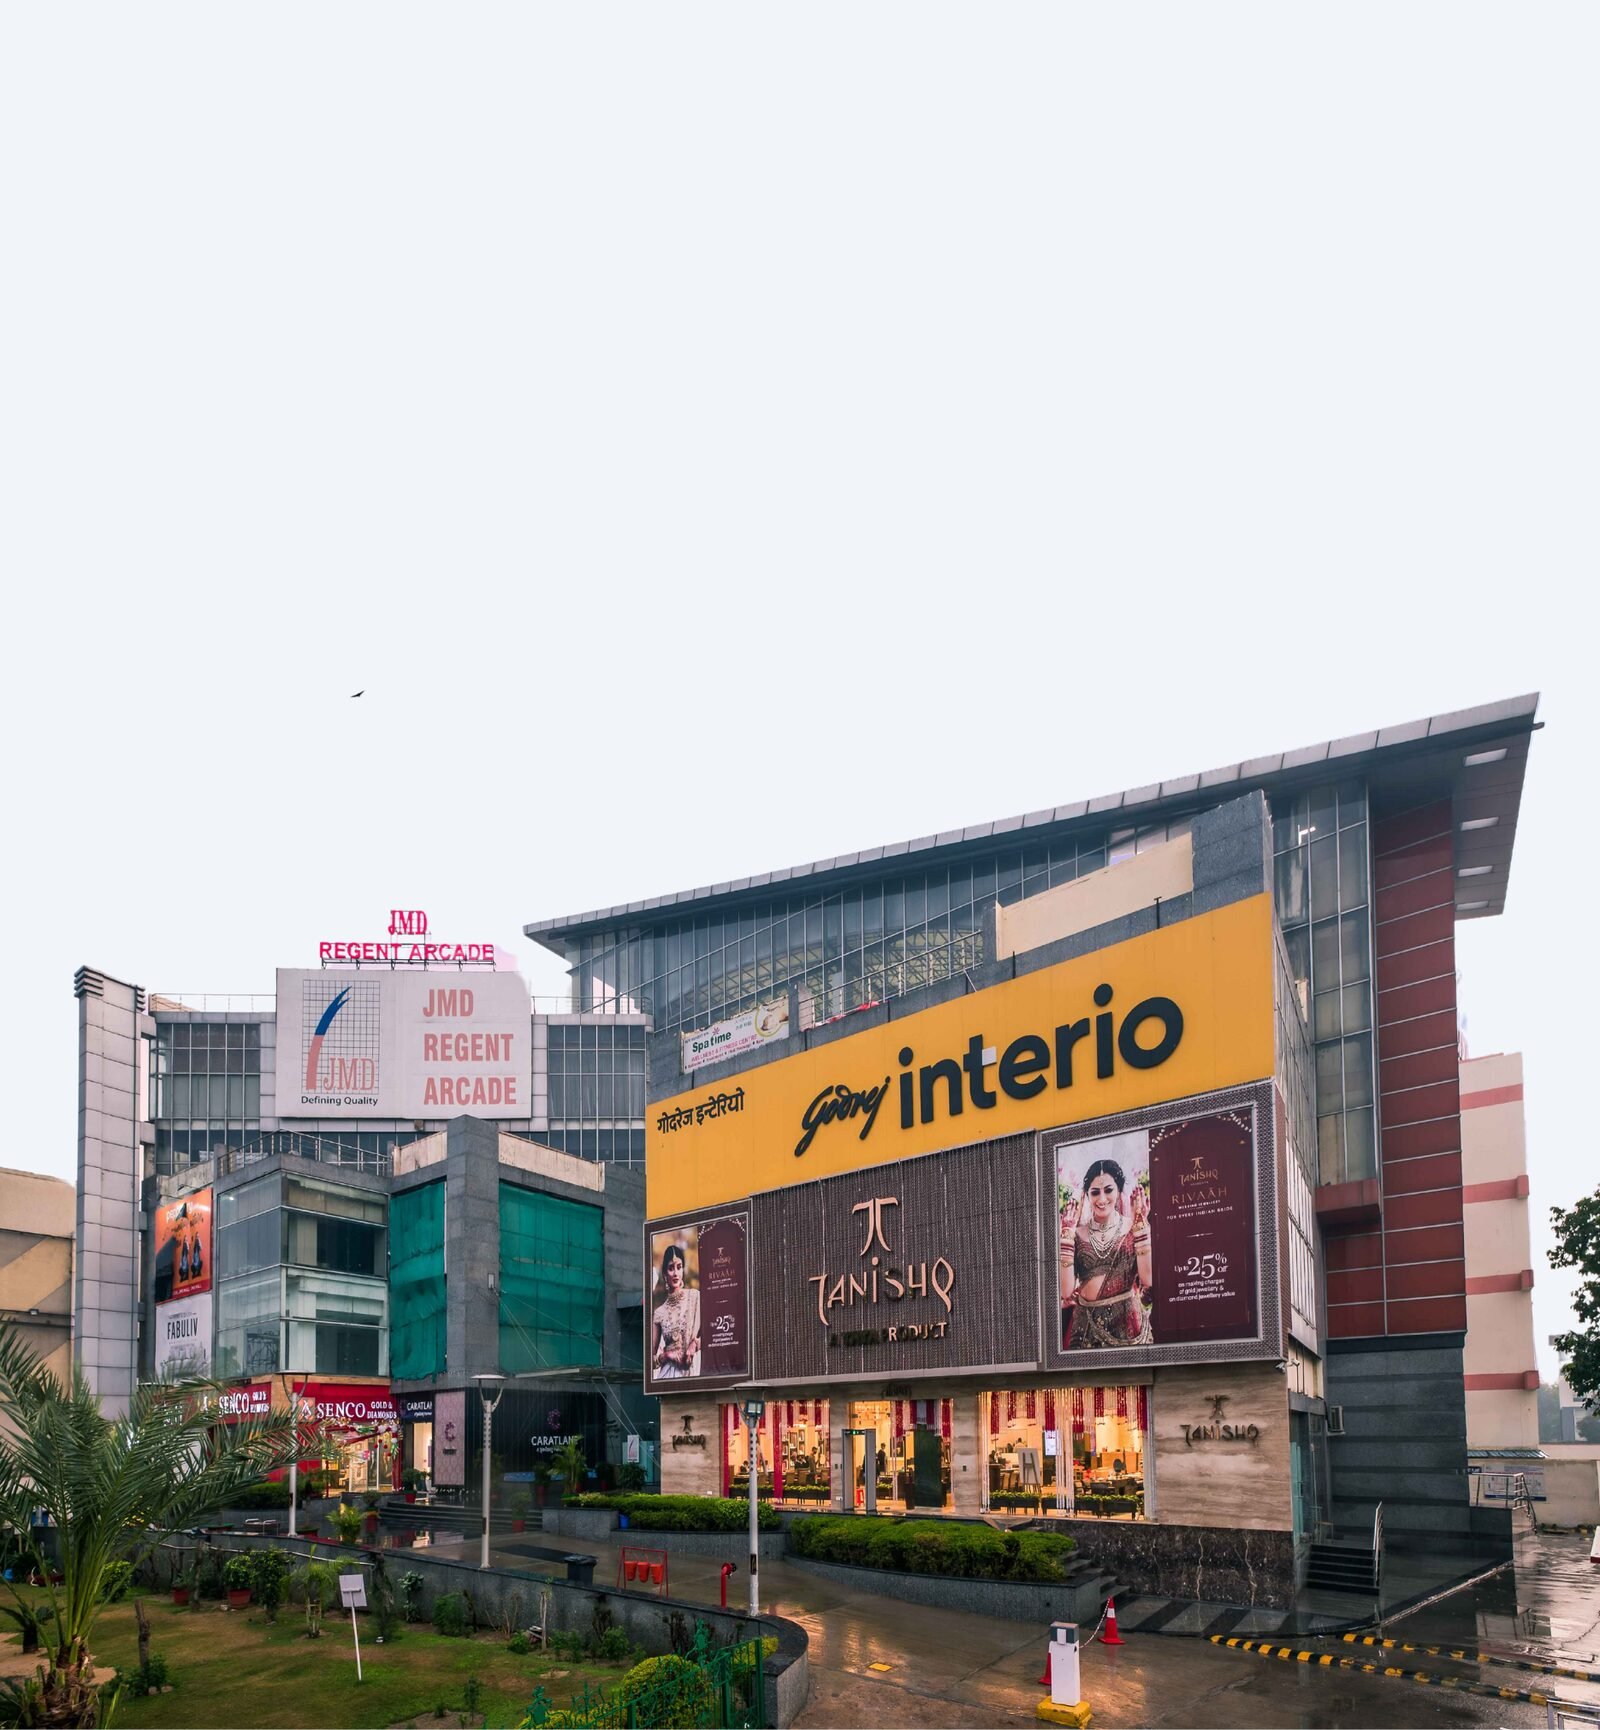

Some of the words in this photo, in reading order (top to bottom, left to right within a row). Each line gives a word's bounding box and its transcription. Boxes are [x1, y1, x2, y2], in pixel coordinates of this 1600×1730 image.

[388, 910, 428, 935] JMD
[320, 942, 401, 960] REGENT
[409, 944, 494, 961] ARCADE
[423, 989, 474, 1018] JMD
[423, 1033, 514, 1062] REGENT
[692, 1041, 709, 1054] Spa
[323, 1057, 375, 1091] JMD
[794, 1075, 890, 1157] Godrej
[898, 983, 1184, 1129] interio
[301, 1096, 342, 1107] Defining
[344, 1096, 378, 1107] Quality
[424, 1077, 517, 1105] ARCADE
[657, 1107, 693, 1134] गोदरेज
[1196, 1208, 1215, 1216] INDIAN
[167, 1317, 199, 1340] FABULIV
[218, 1392, 250, 1418] SENCO
[317, 1401, 366, 1419] SENCO
[371, 1401, 387, 1409] GOLD
[367, 1411, 397, 1419] DIAMONDS
